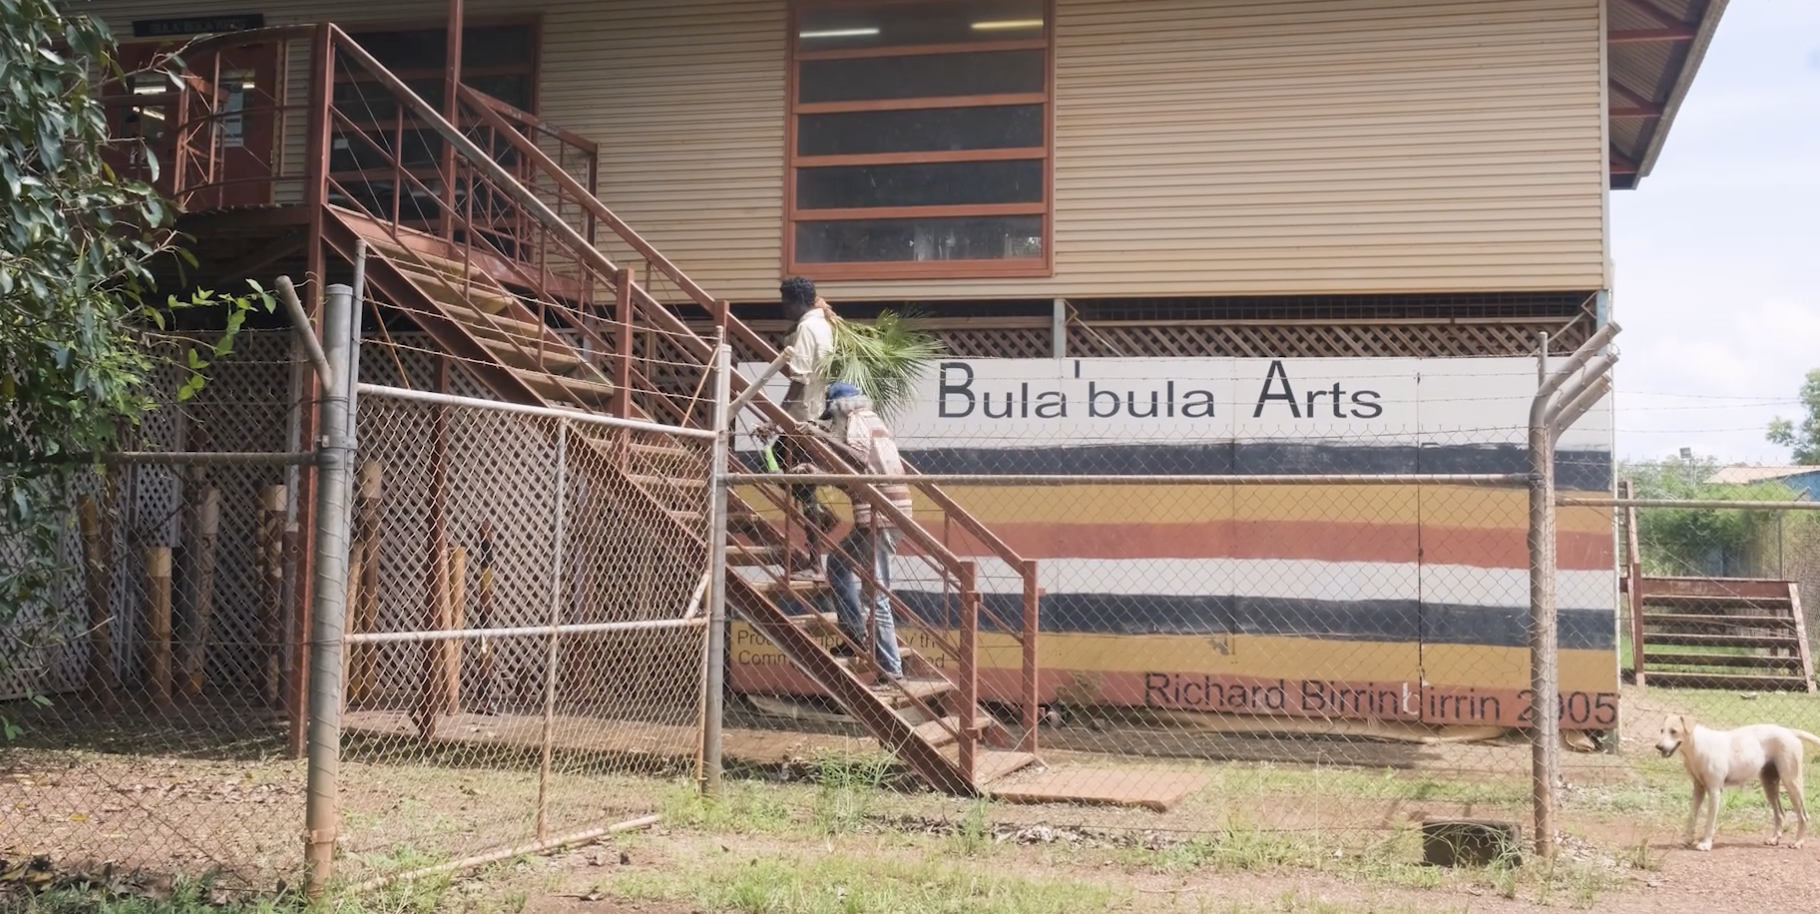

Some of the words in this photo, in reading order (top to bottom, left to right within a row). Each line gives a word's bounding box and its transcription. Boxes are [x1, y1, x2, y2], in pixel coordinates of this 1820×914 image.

[938, 360, 1216, 420] Bula'bula
[1253, 359, 1384, 420] Arts
[1144, 672, 1285, 712] Richard
[1301, 679, 1500, 720] Birrinbirrin
[1517, 690, 1617, 725] 205
